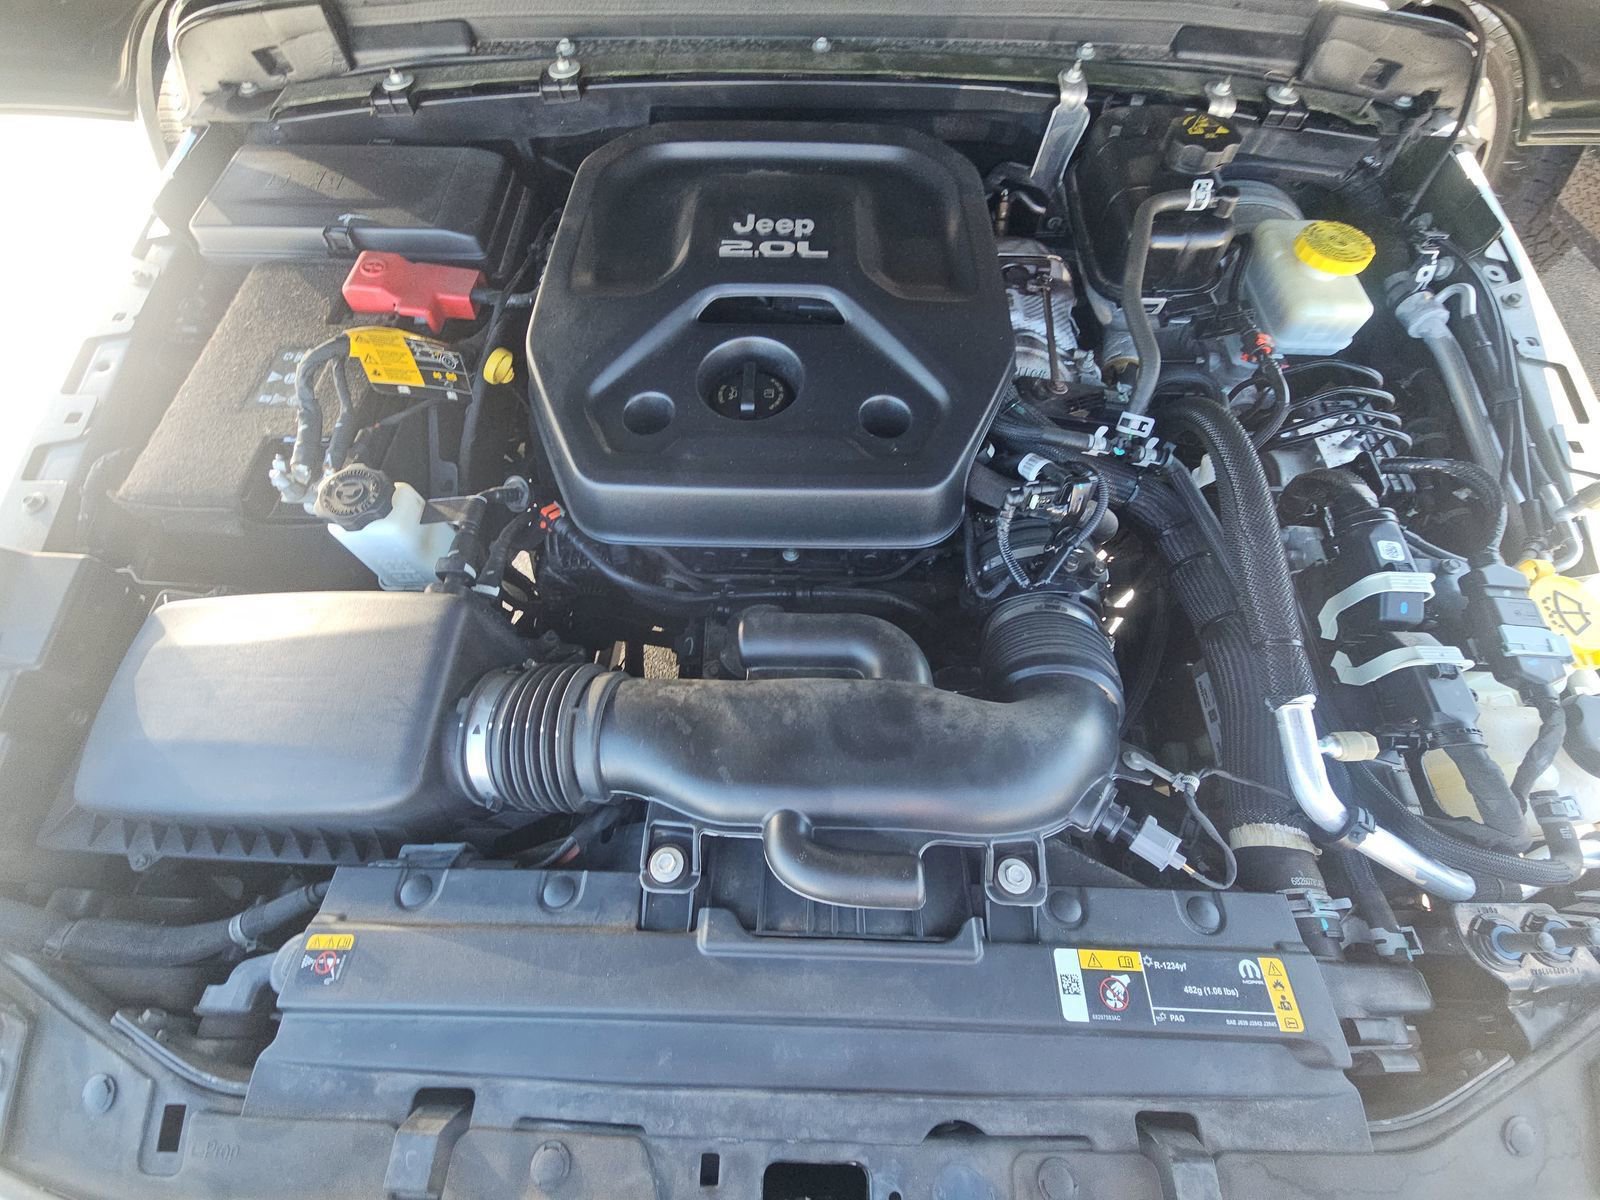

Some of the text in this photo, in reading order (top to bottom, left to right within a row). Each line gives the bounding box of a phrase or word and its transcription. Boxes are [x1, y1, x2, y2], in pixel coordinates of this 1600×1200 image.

[733, 213, 815, 237] Jeep
[719, 240, 828, 258] 2.0L
[1154, 961, 1187, 972] R-1234yf
[1224, 987, 1239, 998] lbs)
